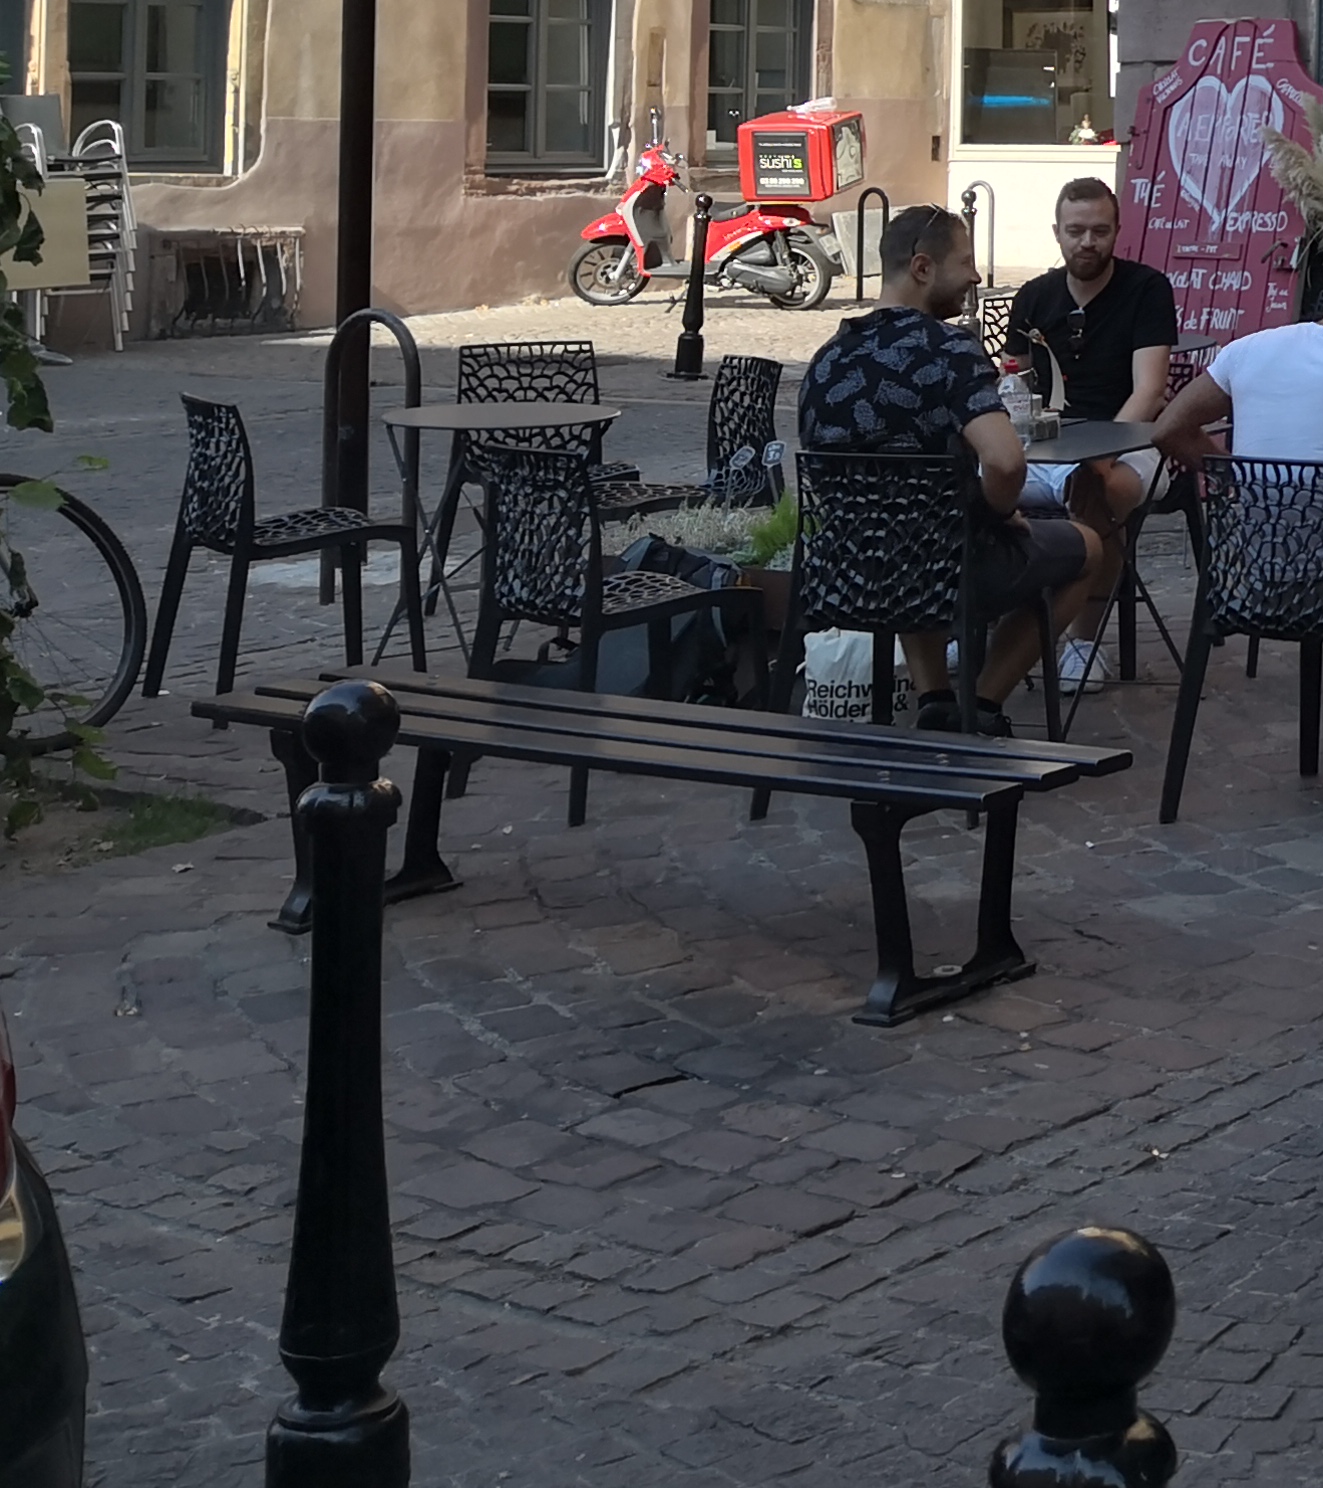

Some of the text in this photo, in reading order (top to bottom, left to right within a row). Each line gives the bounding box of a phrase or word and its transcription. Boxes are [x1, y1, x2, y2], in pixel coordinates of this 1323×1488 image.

[1188, 24, 1275, 75] CAFÉ
[1131, 171, 1166, 209] THÉ
[1226, 210, 1288, 234] EXPRESSO
[1208, 271, 1252, 291] CHAUD
[1184, 309, 1198, 330] de
